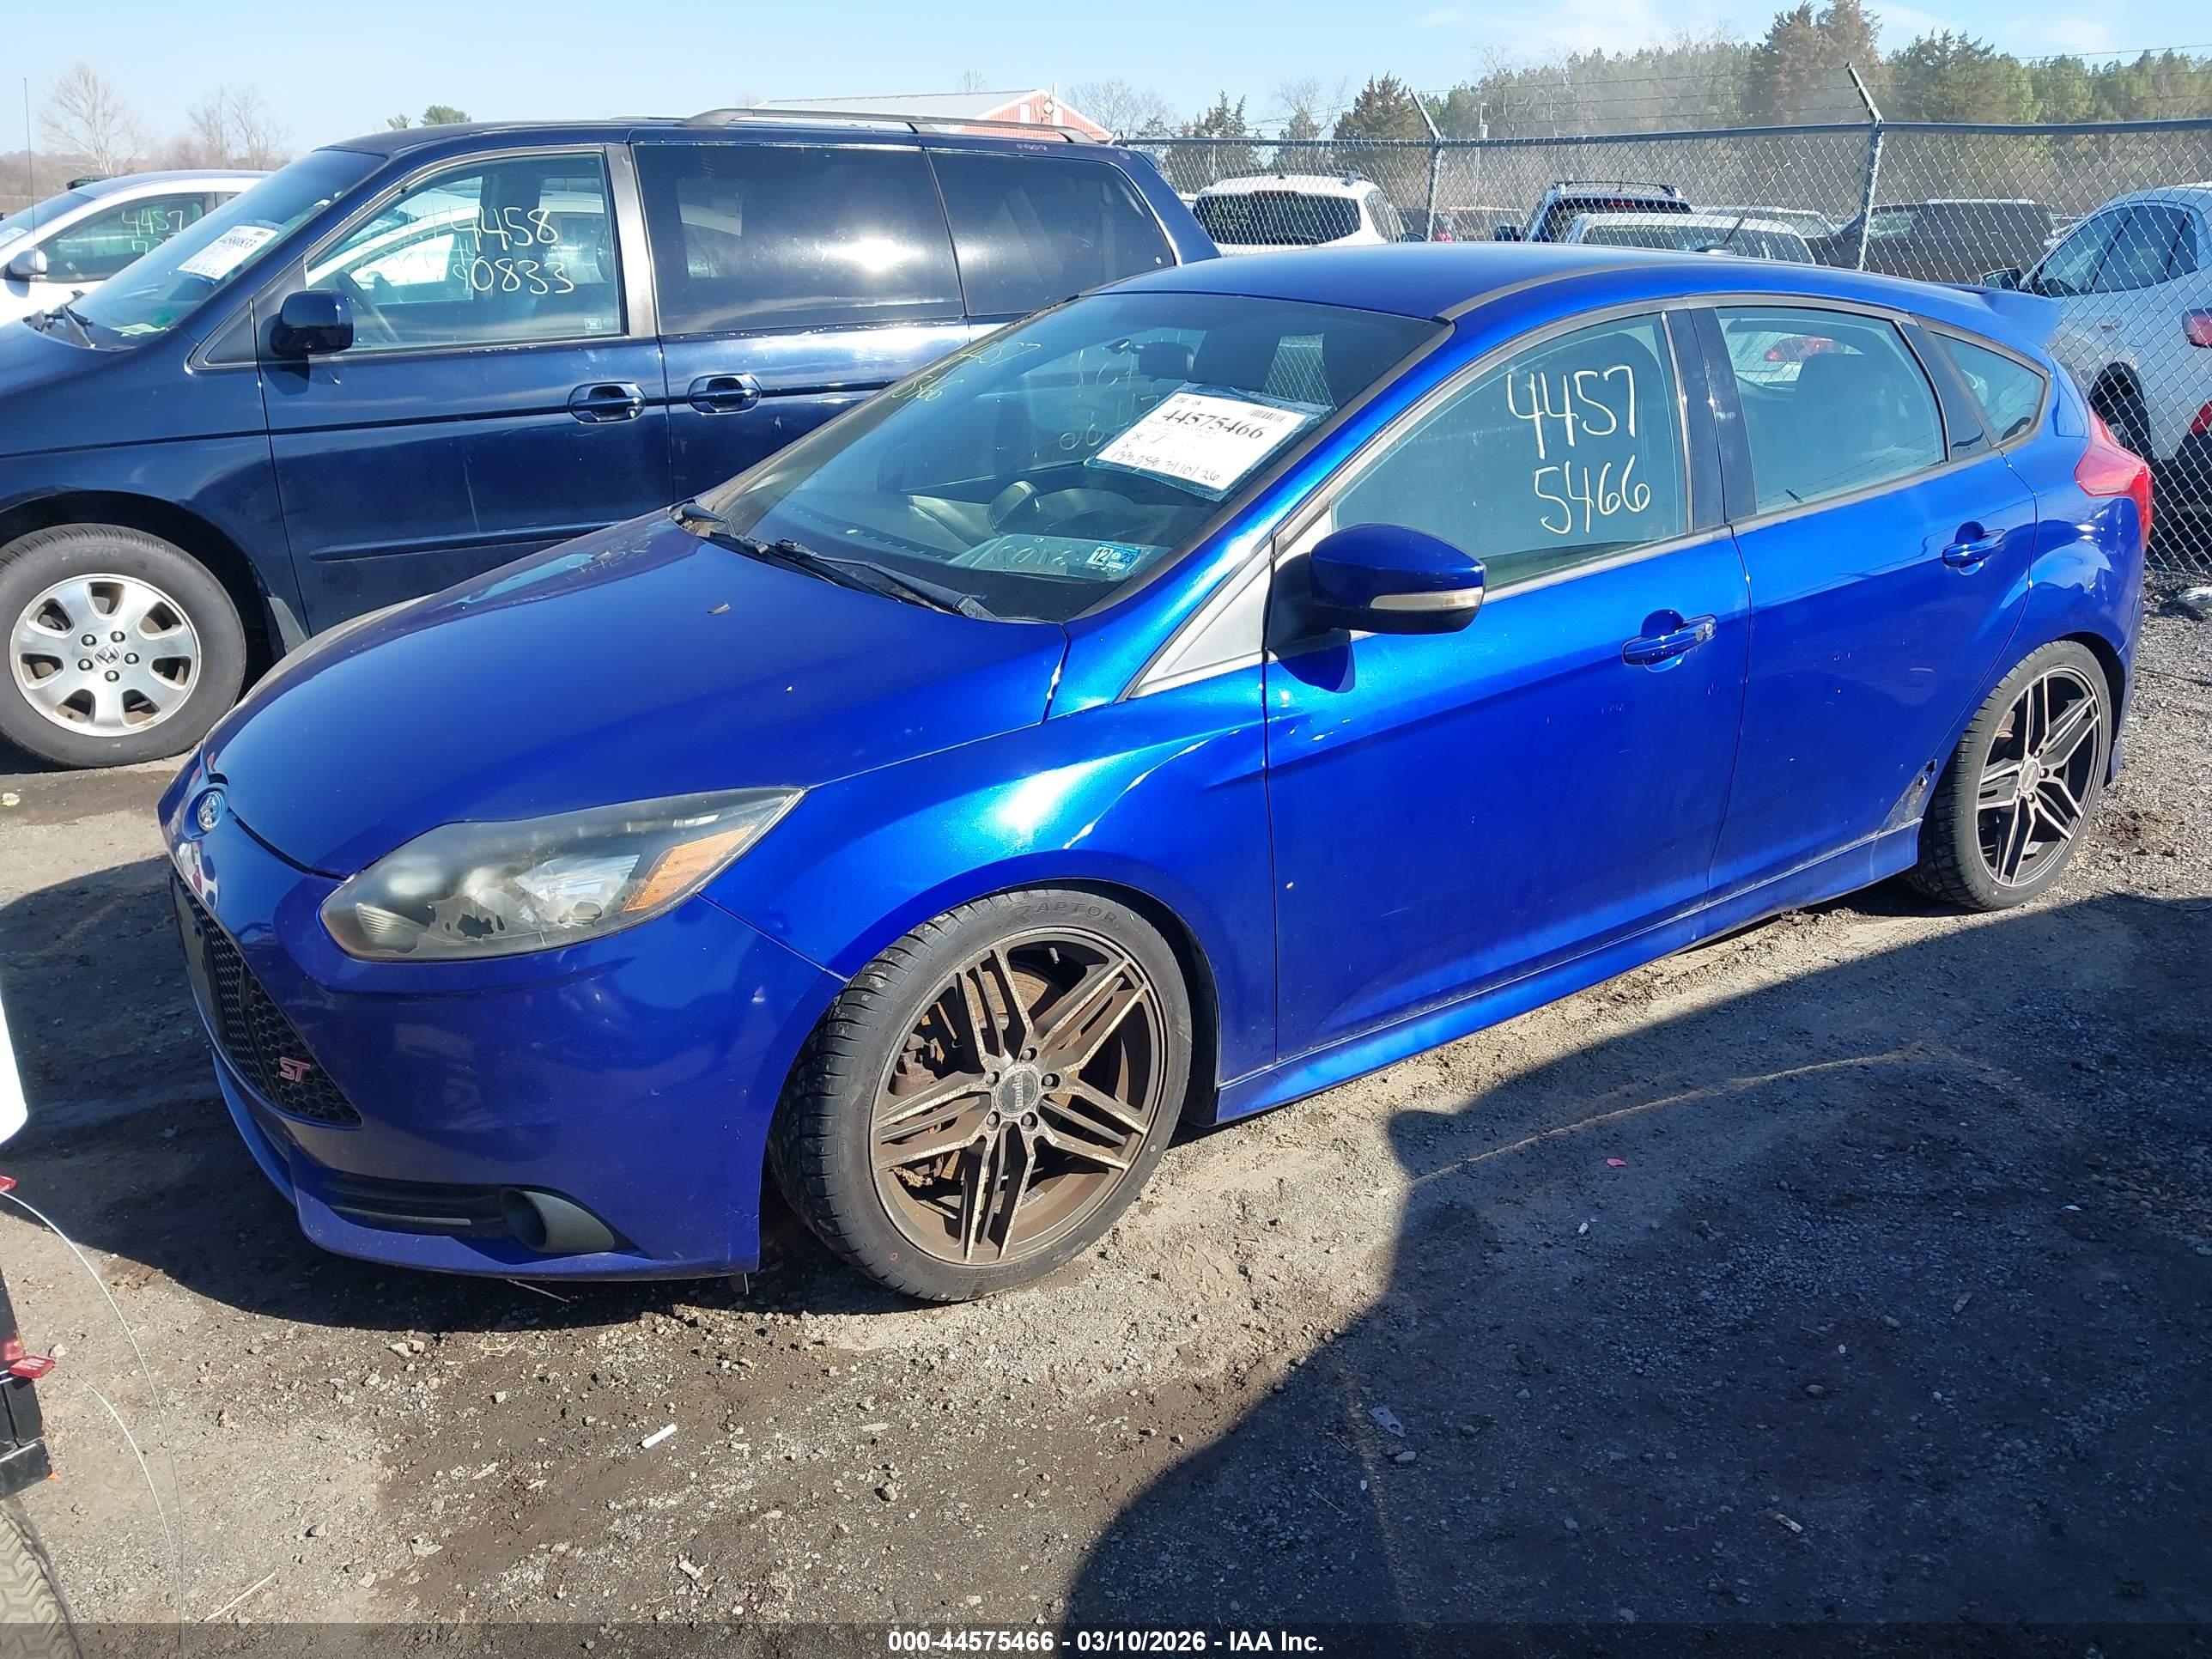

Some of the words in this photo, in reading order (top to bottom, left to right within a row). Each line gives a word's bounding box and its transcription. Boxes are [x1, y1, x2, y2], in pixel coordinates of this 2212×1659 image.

[122, 209, 183, 238] 4457
[448, 205, 559, 252] 4458
[453, 255, 574, 295] 90833
[1162, 409, 1271, 440] 44575466
[1506, 365, 1636, 459] 4457
[1534, 454, 1651, 534] 5466
[1093, 548, 1110, 562] 12
[280, 1056, 310, 1083] ST
